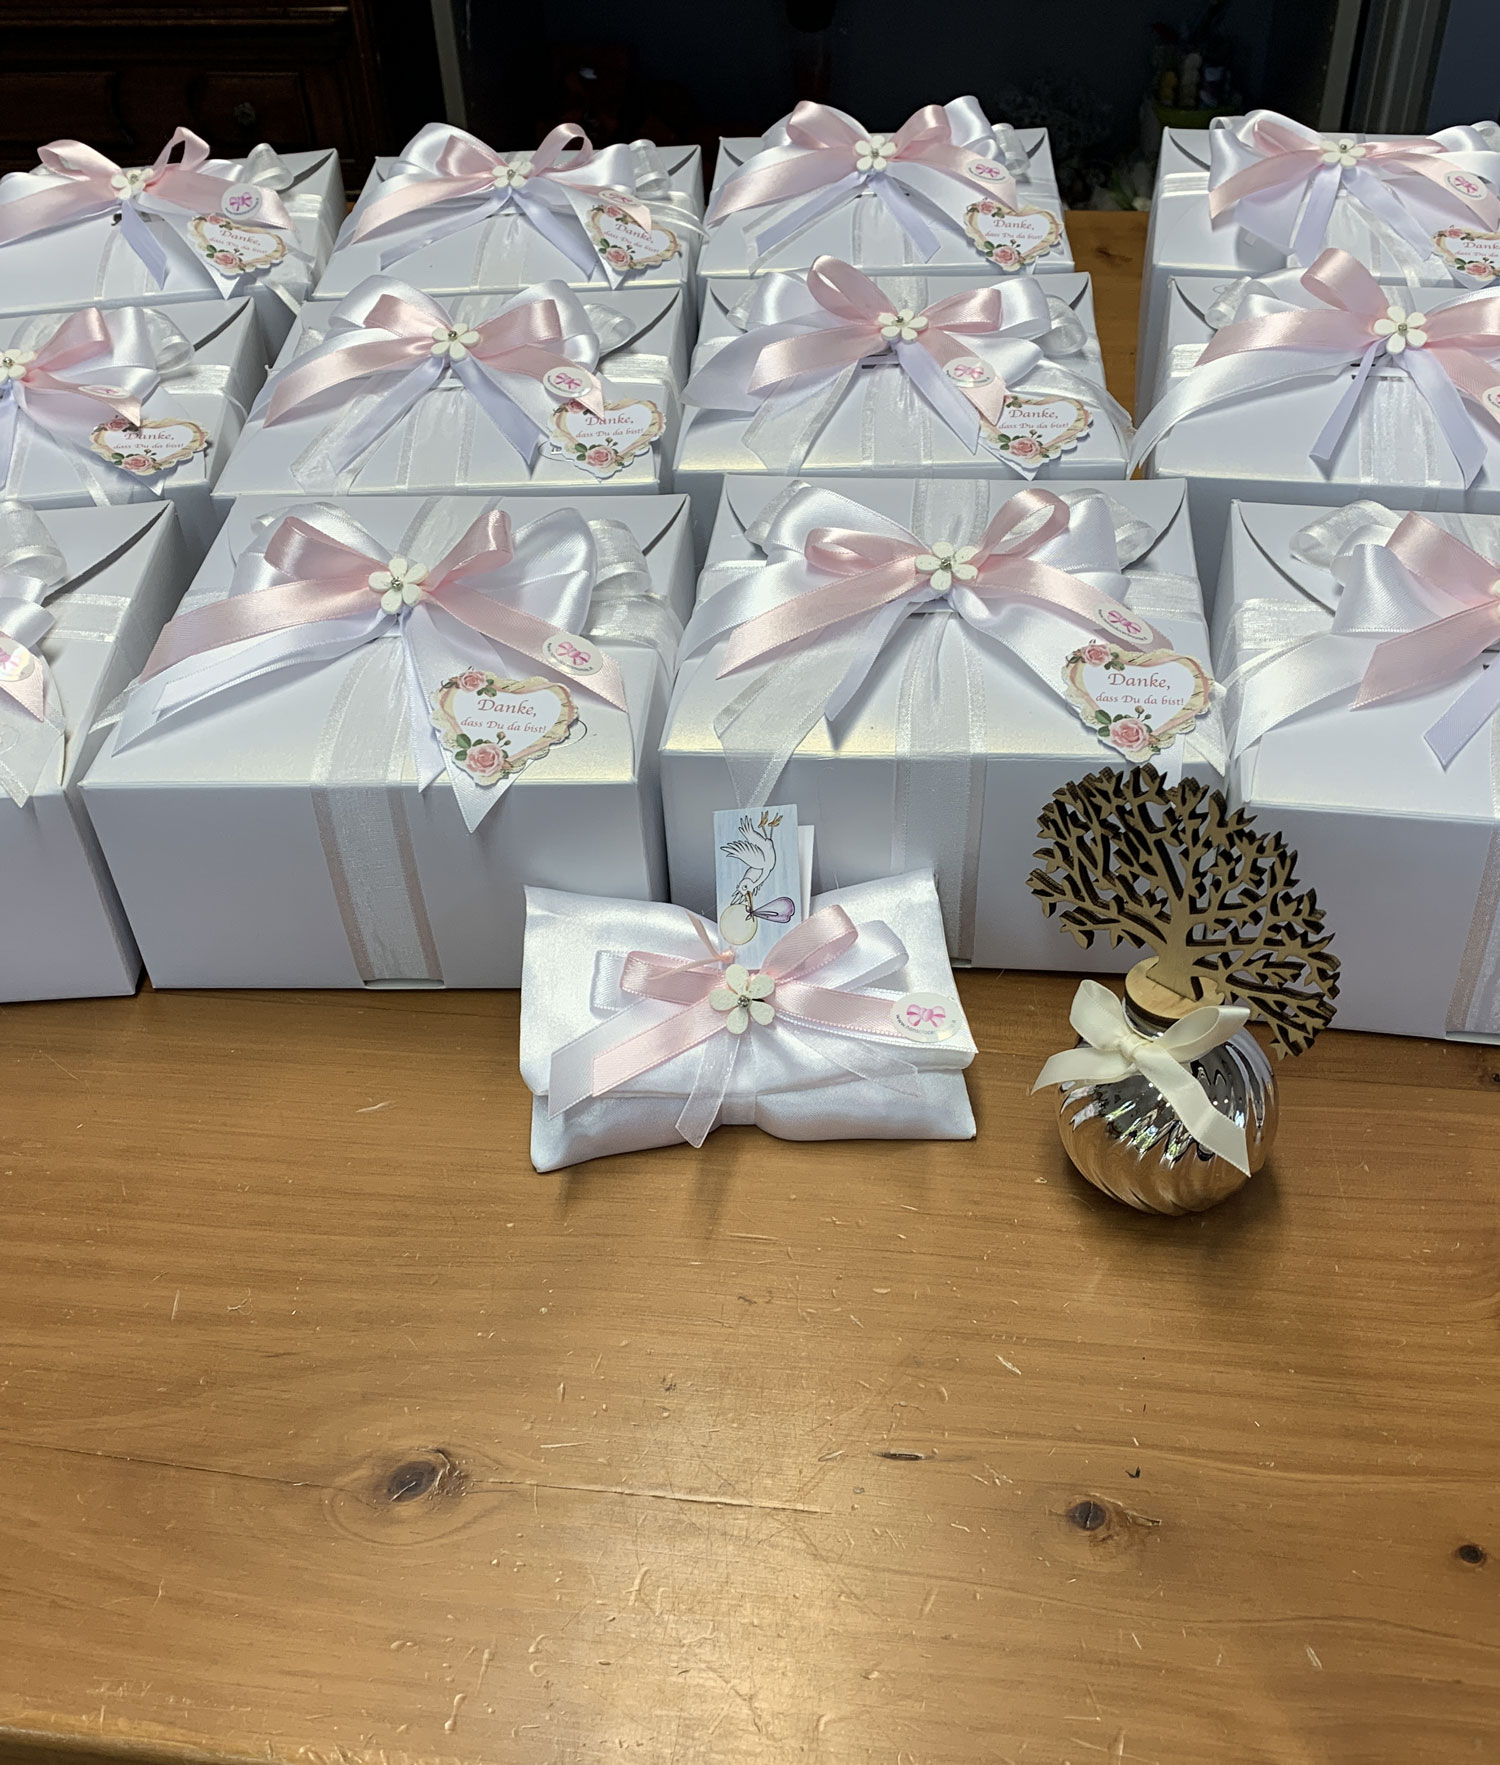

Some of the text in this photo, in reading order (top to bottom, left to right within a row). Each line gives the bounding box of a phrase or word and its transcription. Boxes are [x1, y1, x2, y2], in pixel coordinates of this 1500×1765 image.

[1462, 241, 1500, 250] Dank
[1008, 408, 1059, 419] Danke,
[1107, 673, 1171, 691] Danke,
[1096, 692, 1184, 706] dass Du da bist!
[477, 699, 537, 718] Danke,
[460, 716, 547, 733] dass Du da bist!
